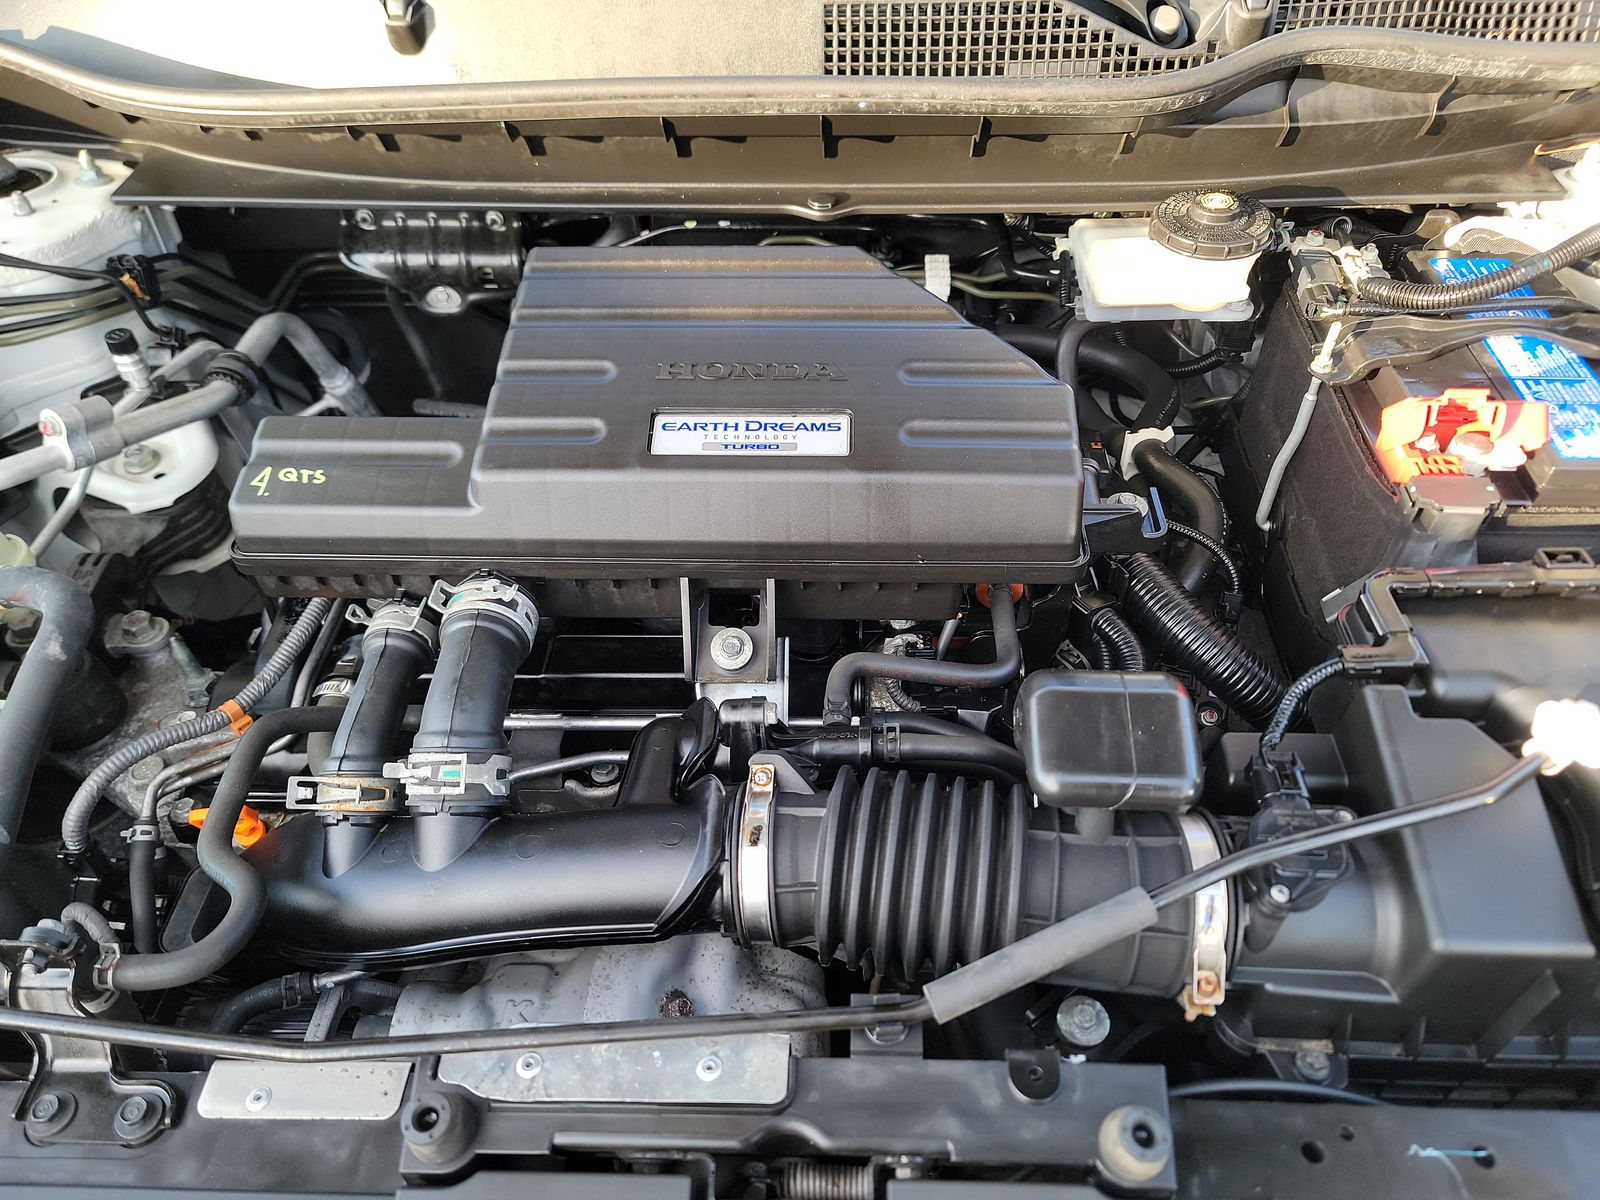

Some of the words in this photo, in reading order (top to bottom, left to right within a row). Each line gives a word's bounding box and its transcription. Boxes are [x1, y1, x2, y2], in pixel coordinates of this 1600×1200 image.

[655, 362, 848, 381] HONDA
[661, 422, 739, 432] EARTH
[744, 420, 842, 432] DREAMS
[278, 467, 327, 485] QTS
